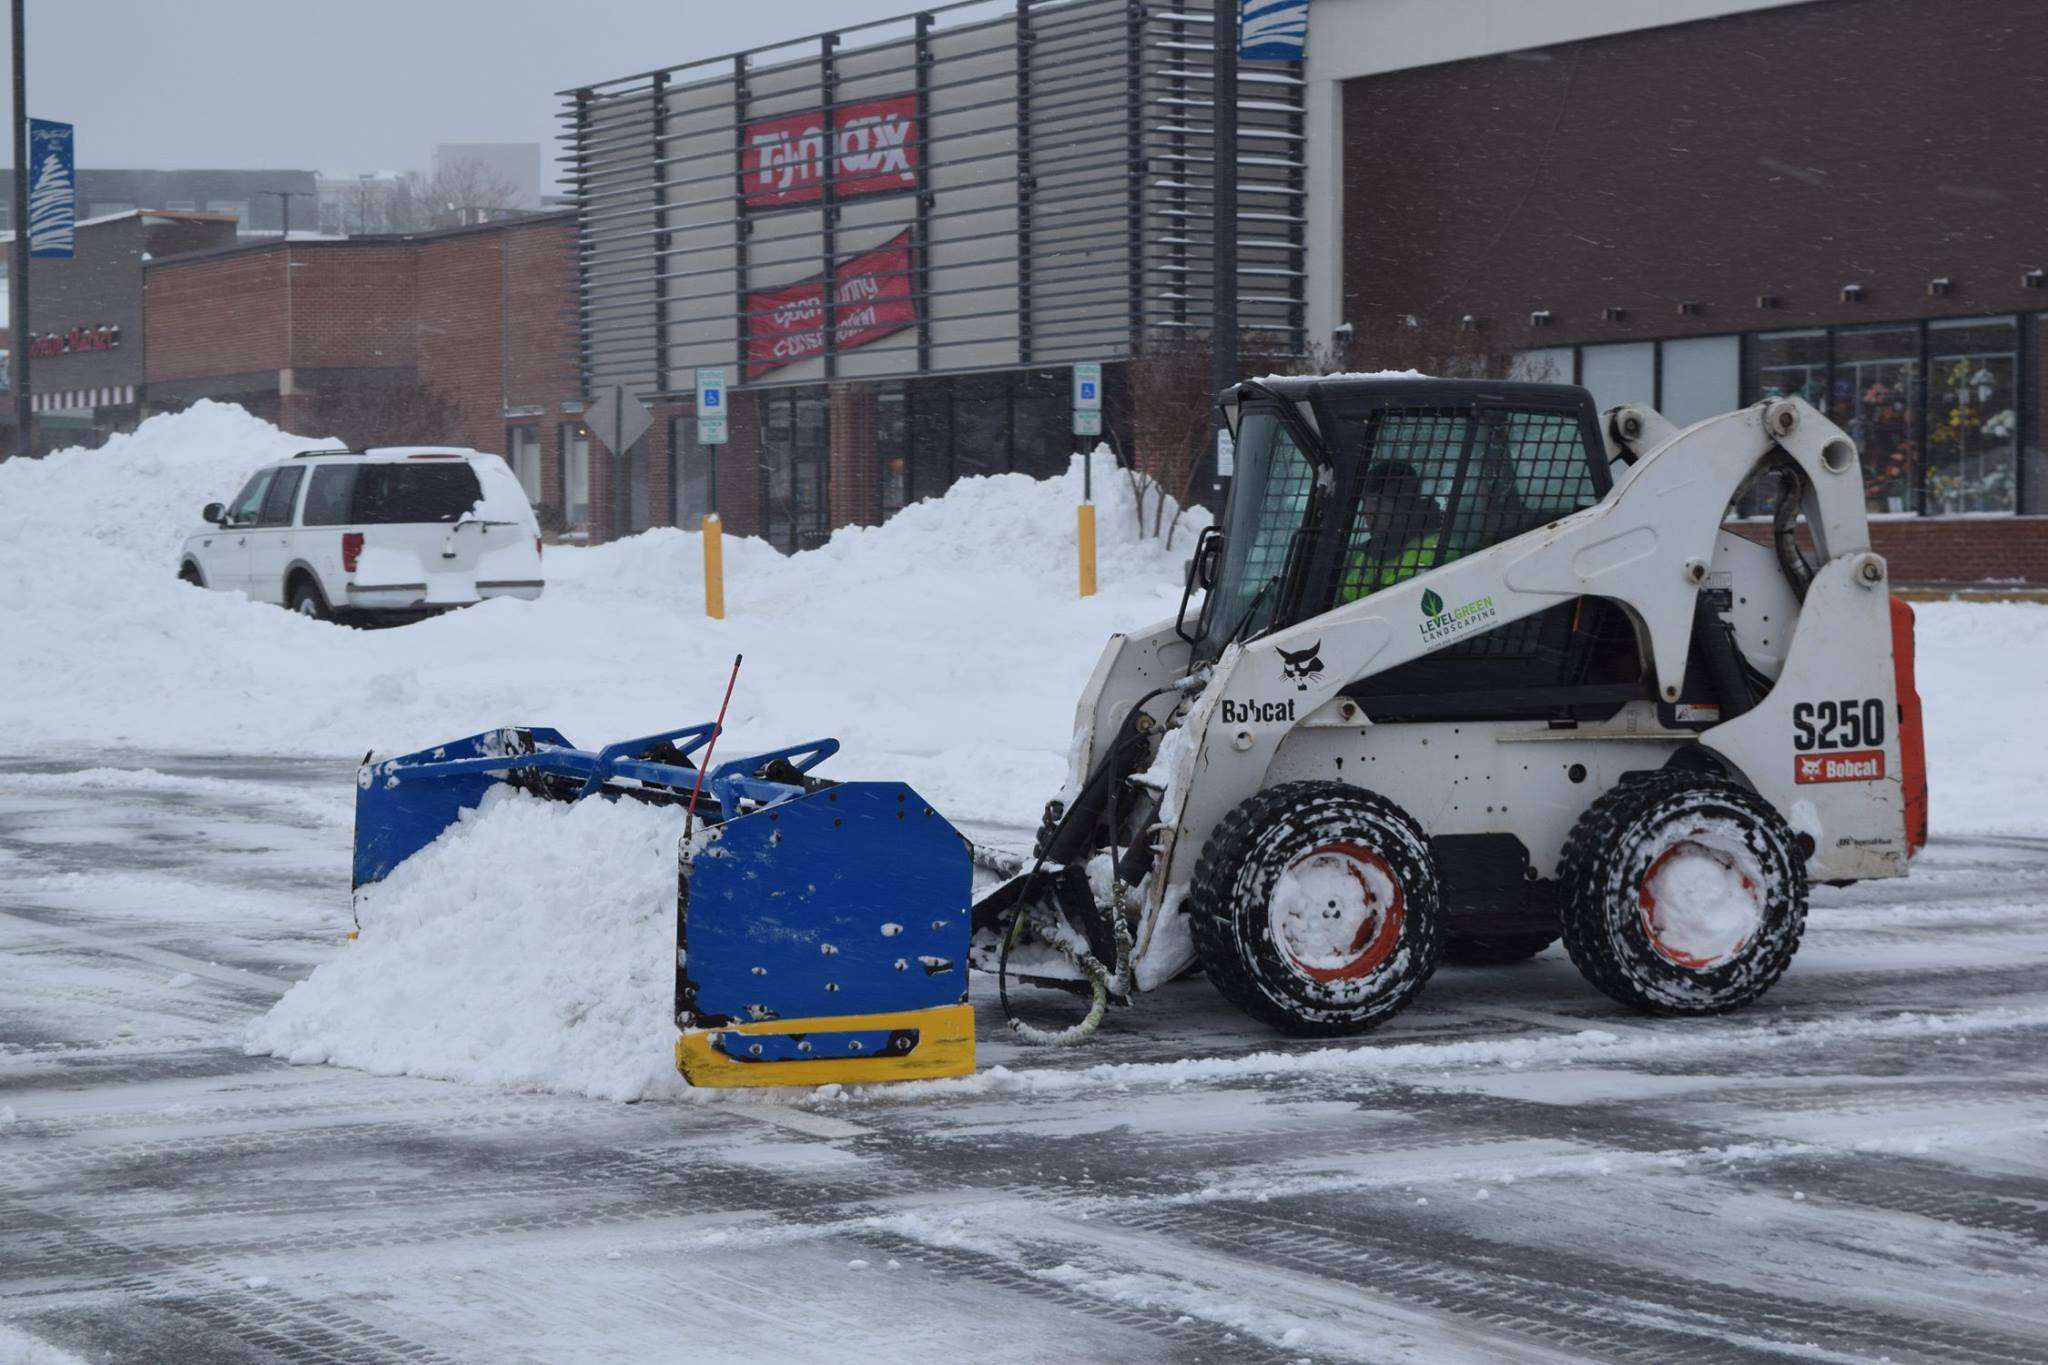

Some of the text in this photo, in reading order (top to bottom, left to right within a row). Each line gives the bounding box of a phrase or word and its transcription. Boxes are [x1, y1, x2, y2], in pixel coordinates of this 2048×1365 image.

[1423, 608, 1496, 643] LANDSCAPING
[1222, 699, 1296, 723] Bobcat
[1793, 698, 1884, 750] S250
[1826, 758, 1878, 779] Bobcat
